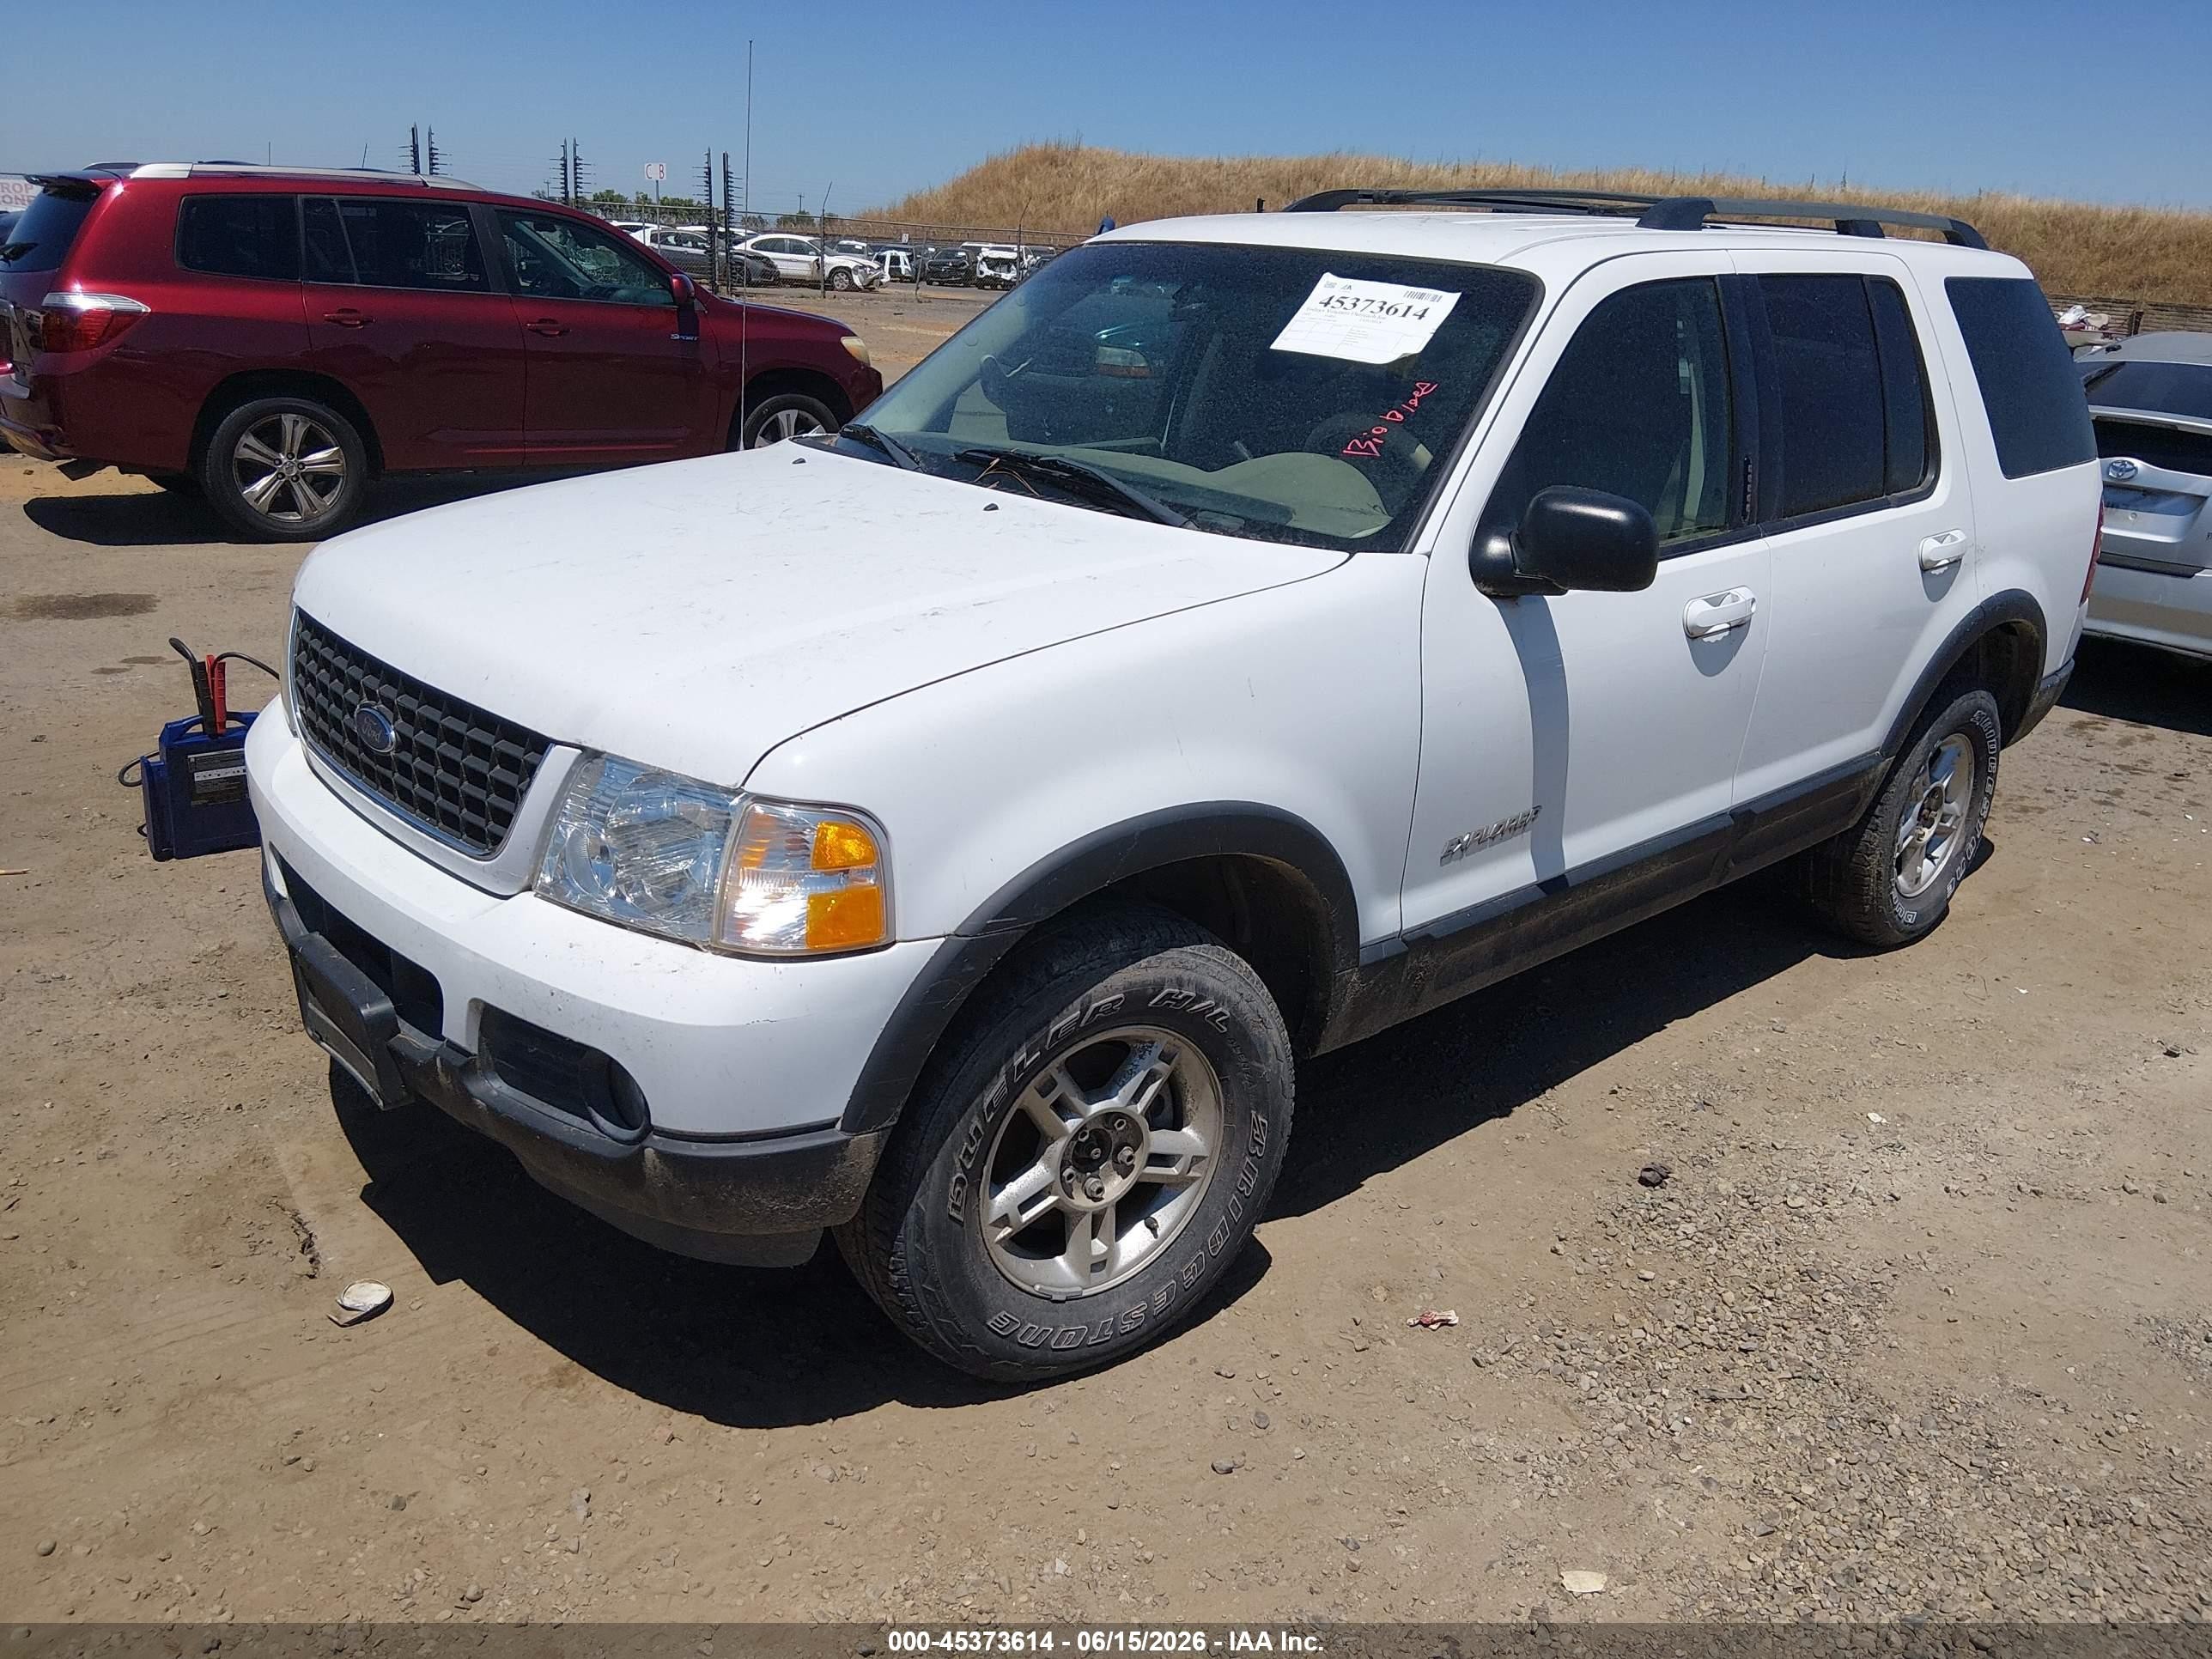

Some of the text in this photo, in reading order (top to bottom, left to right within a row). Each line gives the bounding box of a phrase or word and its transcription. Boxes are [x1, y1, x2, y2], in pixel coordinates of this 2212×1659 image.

[645, 163, 665, 179] C B
[1319, 295, 1430, 320] 45373614
[948, 993, 1126, 1227] DUELER
[1147, 988, 1231, 1033] H/L
[988, 1110, 1269, 1349] BRIDGESTONE
